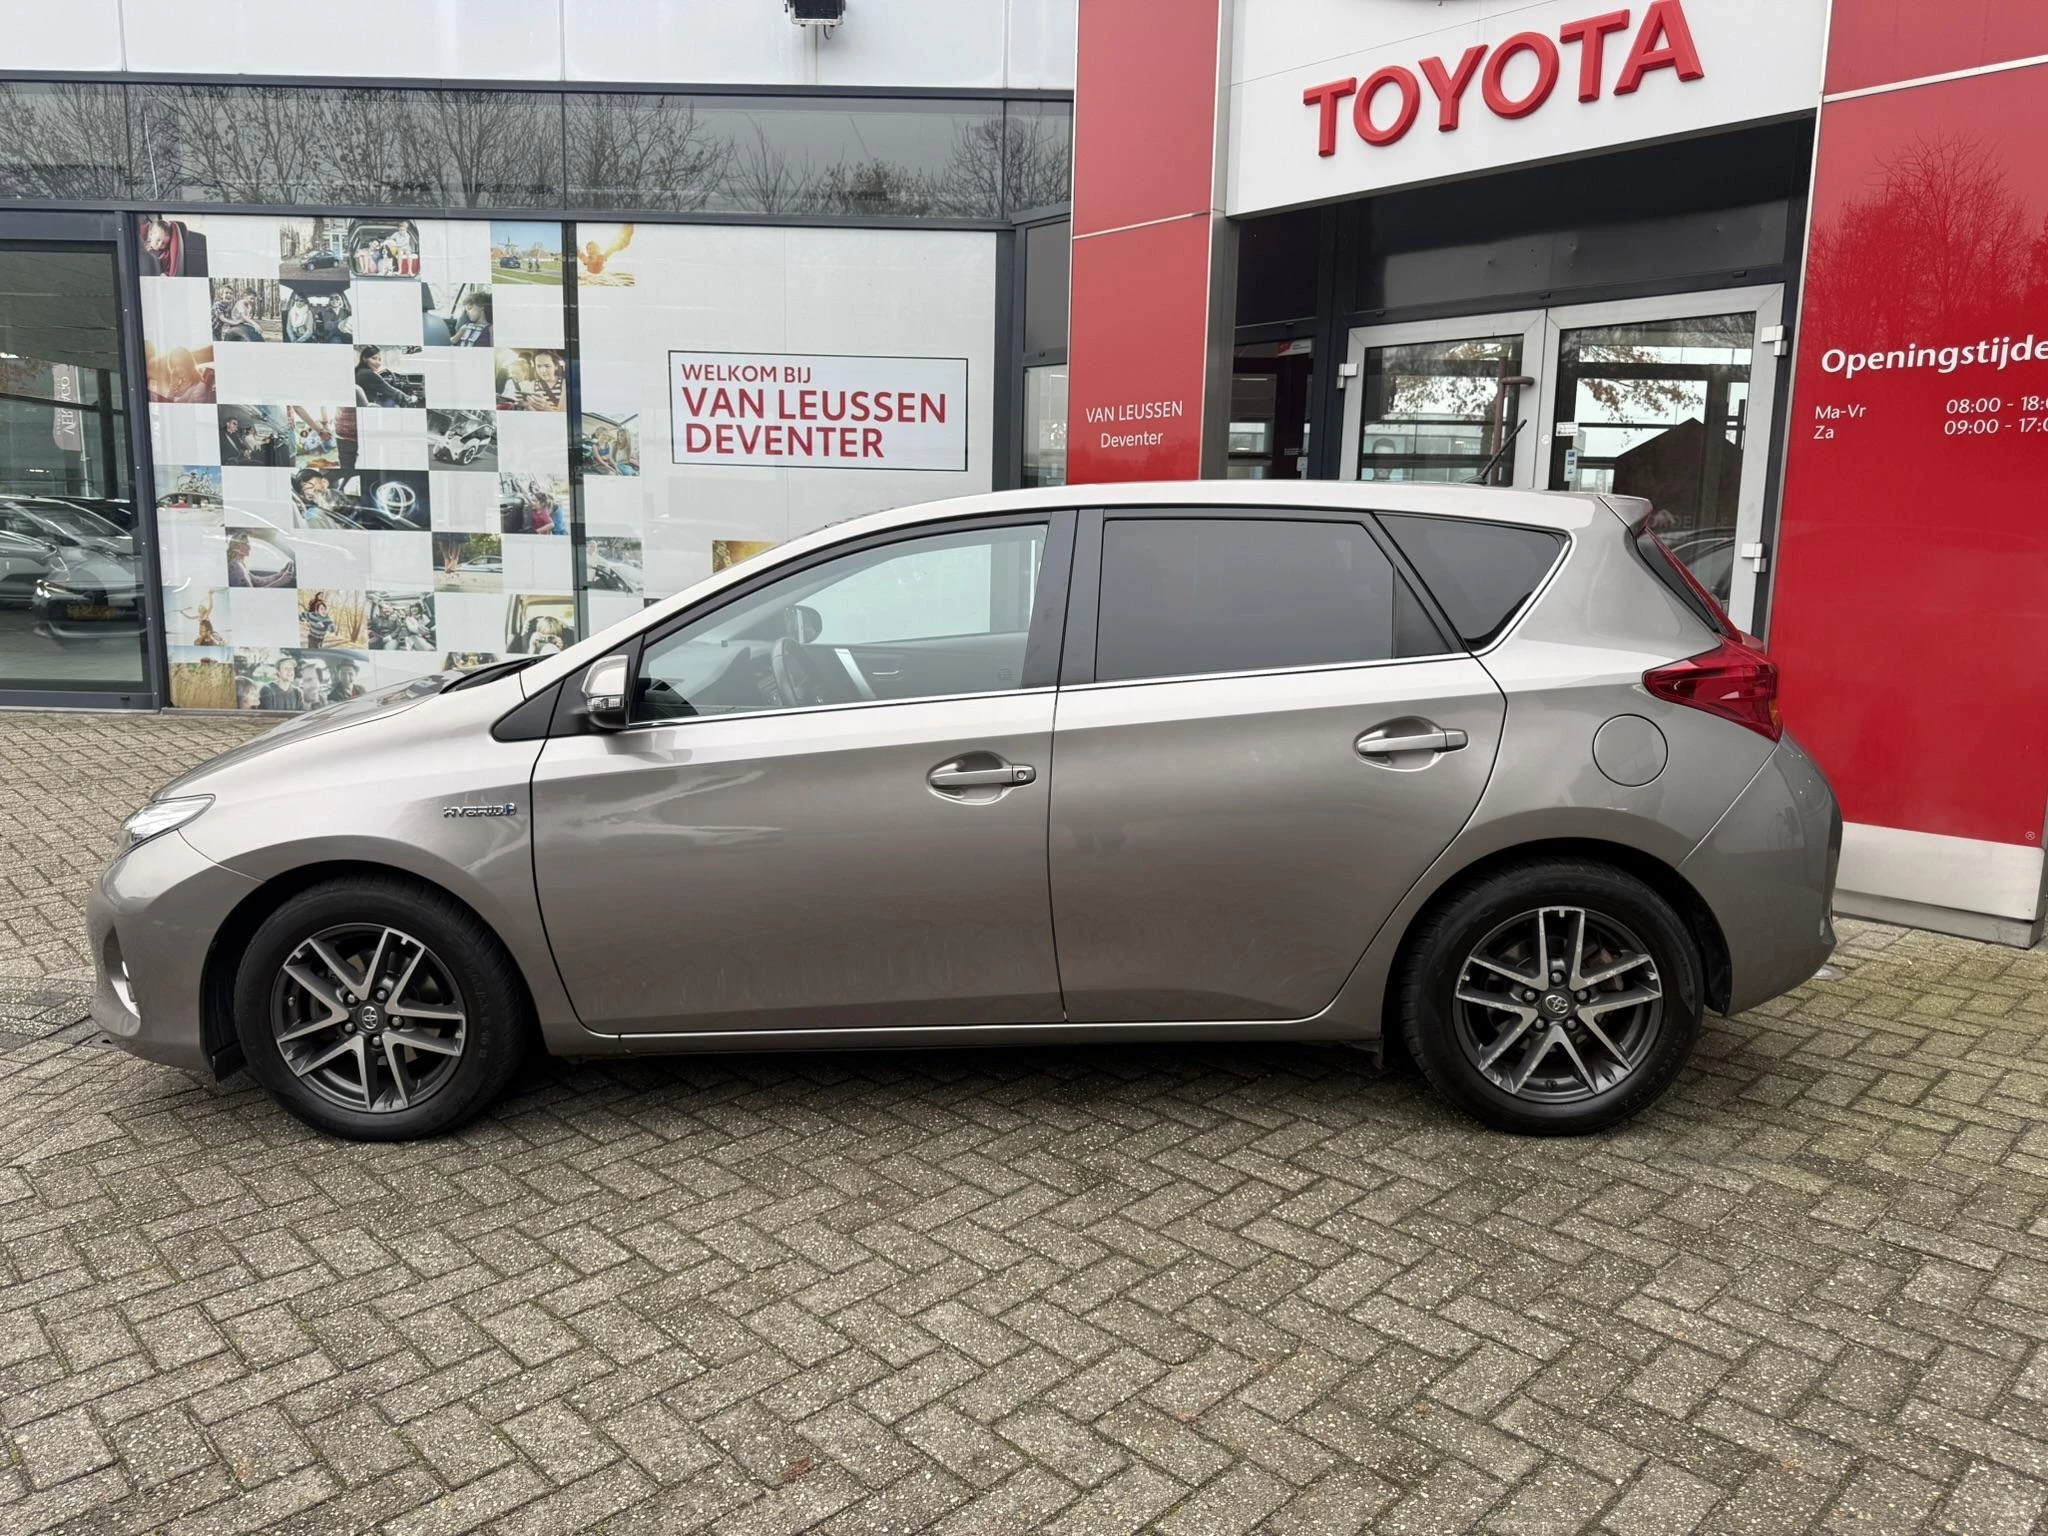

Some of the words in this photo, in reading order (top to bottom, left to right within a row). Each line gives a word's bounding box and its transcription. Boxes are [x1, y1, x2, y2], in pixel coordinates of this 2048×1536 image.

[1303, 0, 1705, 157] TOYOTA
[681, 363, 777, 382] WELKOM
[783, 366, 812, 383] BIJ
[681, 386, 764, 418] VAN
[778, 389, 946, 423] LEUSSEN
[1085, 406, 1115, 423] VAN
[1119, 400, 1183, 421] LEUSSEN
[1815, 404, 1867, 420] Ma-Vr
[1946, 397, 2001, 414] 08:00
[2020, 395, 2048, 411] 18:
[685, 423, 884, 458] DEVENTER
[1101, 431, 1163, 448] Deventer
[1813, 426, 1834, 440] Za
[1944, 419, 1999, 435] 09:00
[443, 805, 504, 818] HYBRID
